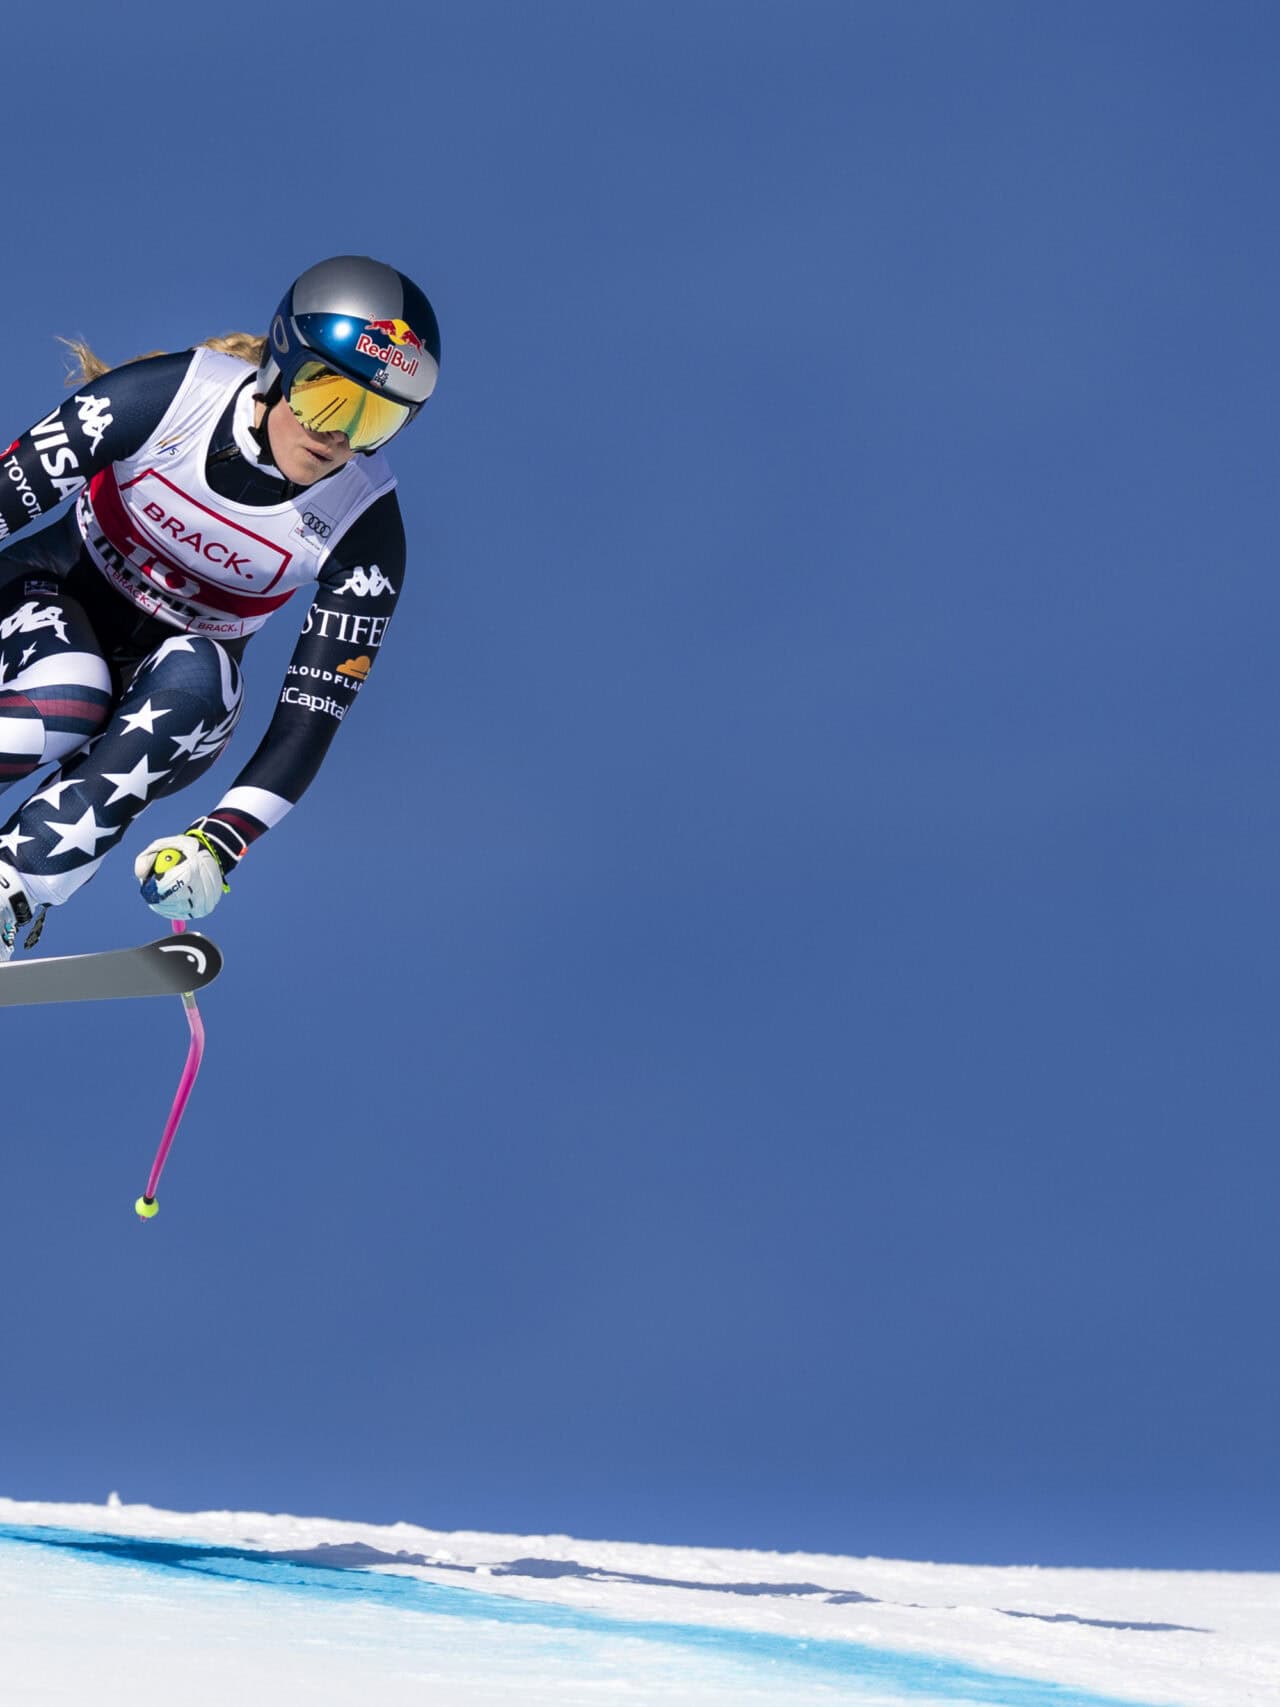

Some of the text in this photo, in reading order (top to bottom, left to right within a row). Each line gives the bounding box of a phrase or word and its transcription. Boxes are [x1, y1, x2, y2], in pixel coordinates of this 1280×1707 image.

[356, 333, 419, 377] Red Bull
[30, 405, 87, 500] VISA
[142, 502, 254, 580] BRACK.
[112, 571, 151, 608] BRACK.
[197, 622, 238, 633] BRACK.
